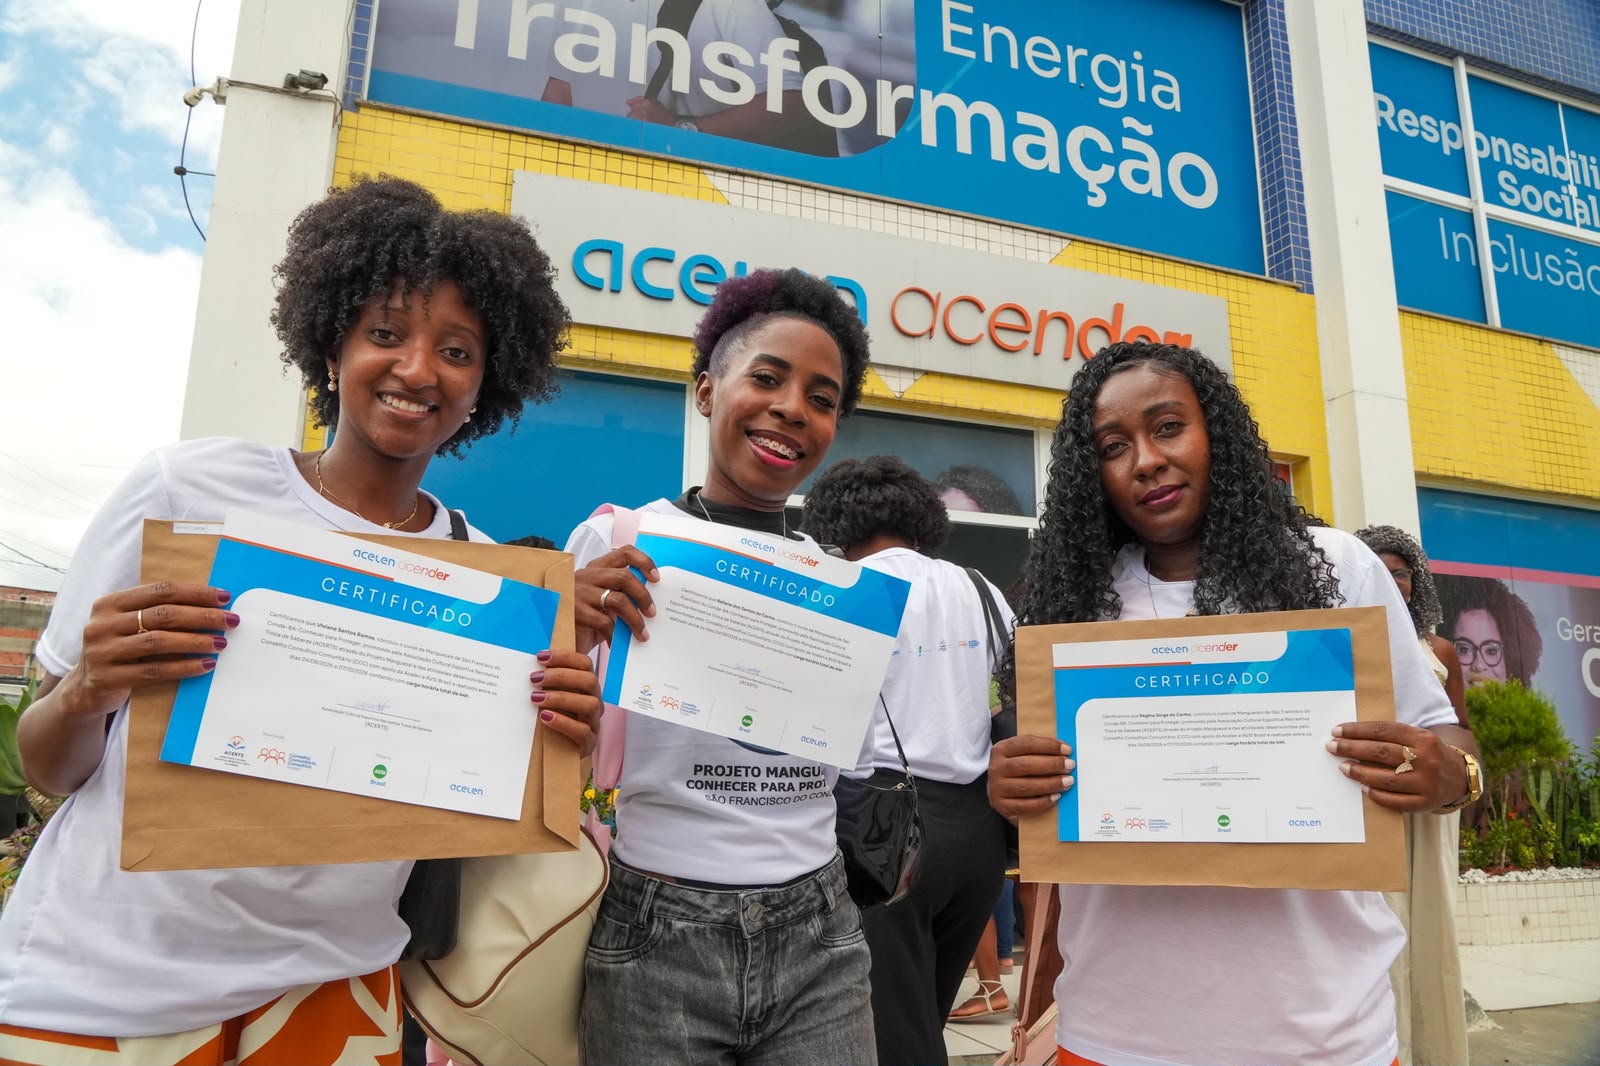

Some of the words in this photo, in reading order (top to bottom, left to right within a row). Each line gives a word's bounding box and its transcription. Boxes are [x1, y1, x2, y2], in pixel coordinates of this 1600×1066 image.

[941, 0, 1181, 112] Energia
[1498, 170, 1600, 228] Social
[572, 239, 867, 328] acen
[740, 537, 775, 554] acelen
[777, 549, 819, 568] acender
[353, 549, 396, 567] acelen
[398, 561, 450, 581] acender
[716, 560, 834, 607] CERTIFICADO
[322, 578, 472, 627] CERTIFICADO
[316, 623, 337, 632] Viviane
[337, 628, 356, 636] Santos
[1152, 646, 1188, 654] acelen
[1191, 642, 1238, 652] acender
[1135, 672, 1269, 688] CERTIFICADO
[800, 735, 827, 748] acelen
[694, 764, 762, 778] PROJETO
[766, 766, 823, 778] MANGU
[370, 779, 386, 787] Brasil
[450, 784, 484, 796] acelen
[686, 780, 756, 792] CONHECER
[761, 782, 795, 792] PARA
[705, 794, 726, 804] SÃO
[728, 796, 791, 806] FRANCISCO
